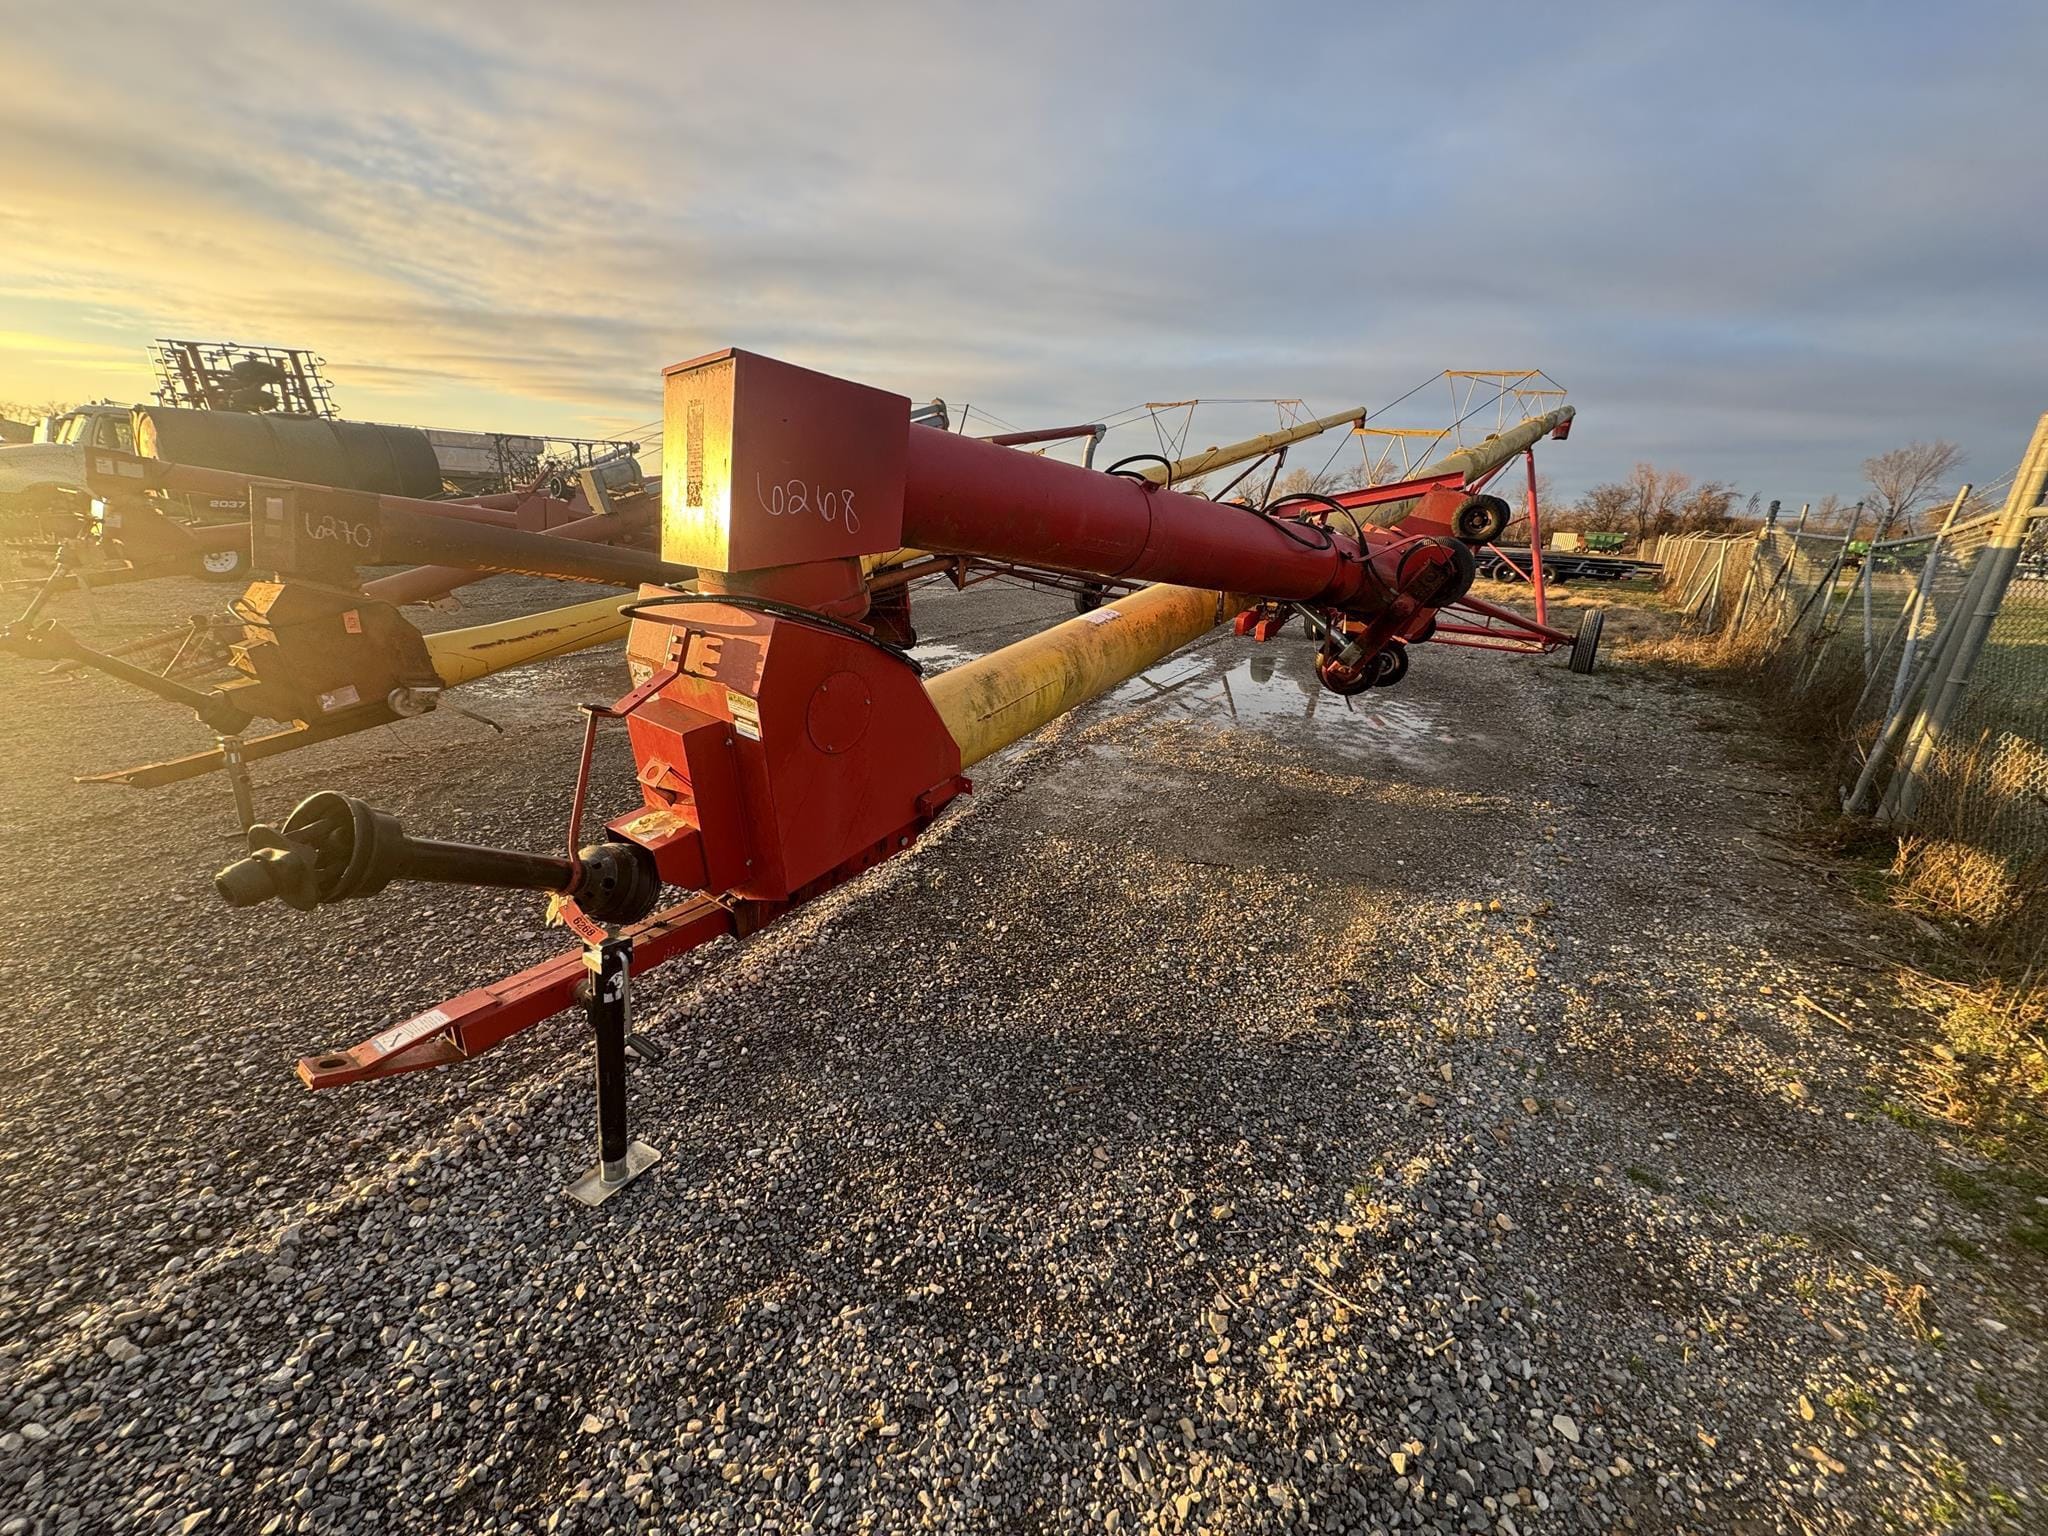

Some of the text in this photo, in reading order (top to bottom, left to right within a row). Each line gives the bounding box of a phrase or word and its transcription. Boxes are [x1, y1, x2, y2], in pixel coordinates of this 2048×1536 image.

[210, 500, 247, 508] 2037
[757, 472, 861, 534] 6268
[305, 512, 372, 548] 6270
[573, 916, 596, 936] 6268
